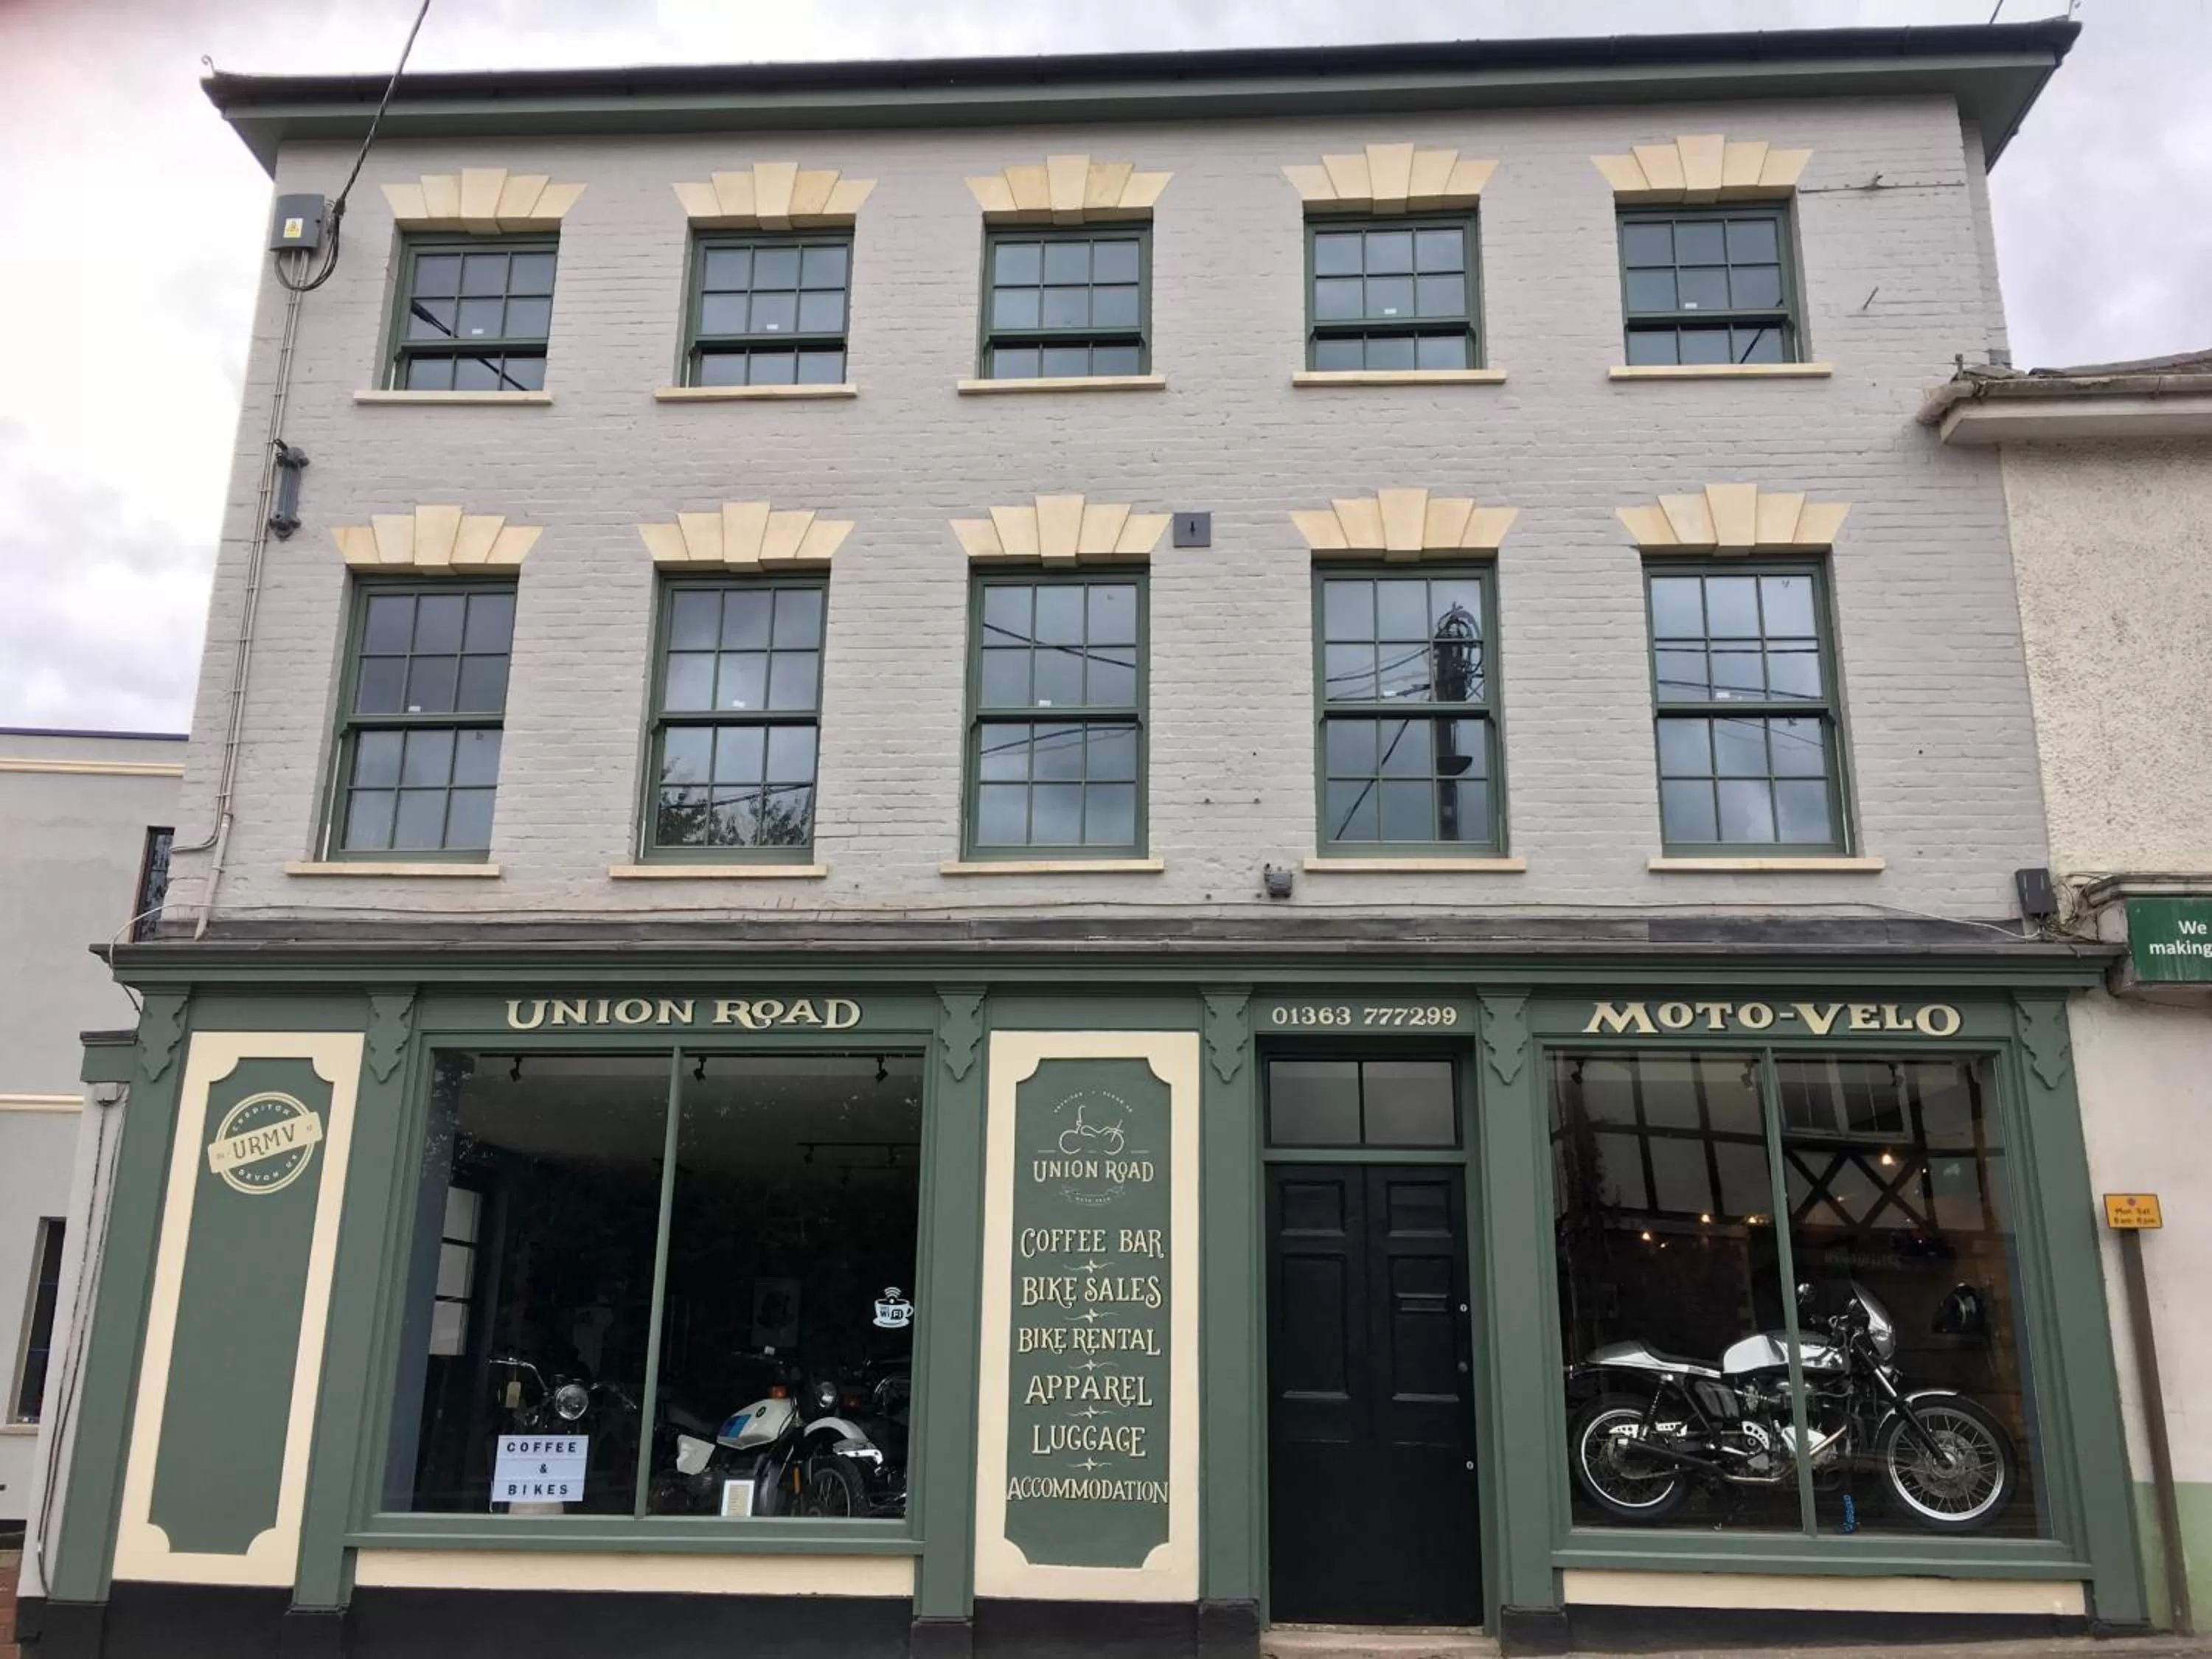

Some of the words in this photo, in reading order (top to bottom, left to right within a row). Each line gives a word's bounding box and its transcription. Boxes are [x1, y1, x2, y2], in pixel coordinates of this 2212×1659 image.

[2178, 920, 2208, 935] We
[2149, 940, 2212, 958] making
[506, 998, 695, 1029] UNION
[712, 998, 863, 1029] ROAD
[1272, 1006, 1352, 1026] 01363
[1363, 1006, 1458, 1026] 777299
[1582, 1001, 1962, 1037] MOTO-VELO
[232, 1124, 295, 1159] URMV
[1033, 1160, 1099, 1183] UNION
[1105, 1160, 1155, 1184] ROAD
[1020, 1228, 1107, 1258] COFFEE
[1119, 1229, 1164, 1259] BAR
[1020, 1276, 1077, 1309] BIKE
[1085, 1276, 1162, 1309] SALES
[1018, 1328, 1067, 1354] BIKE
[1073, 1328, 1161, 1356] RENTAL
[1024, 1375, 1152, 1408] APPAREL
[507, 1441, 576, 1453] COFFEE
[1032, 1425, 1146, 1457] LUGGAGE
[539, 1463, 548, 1474] &
[508, 1484, 568, 1495] BIKES
[1006, 1476, 1169, 1503] ACCOMMODATION
